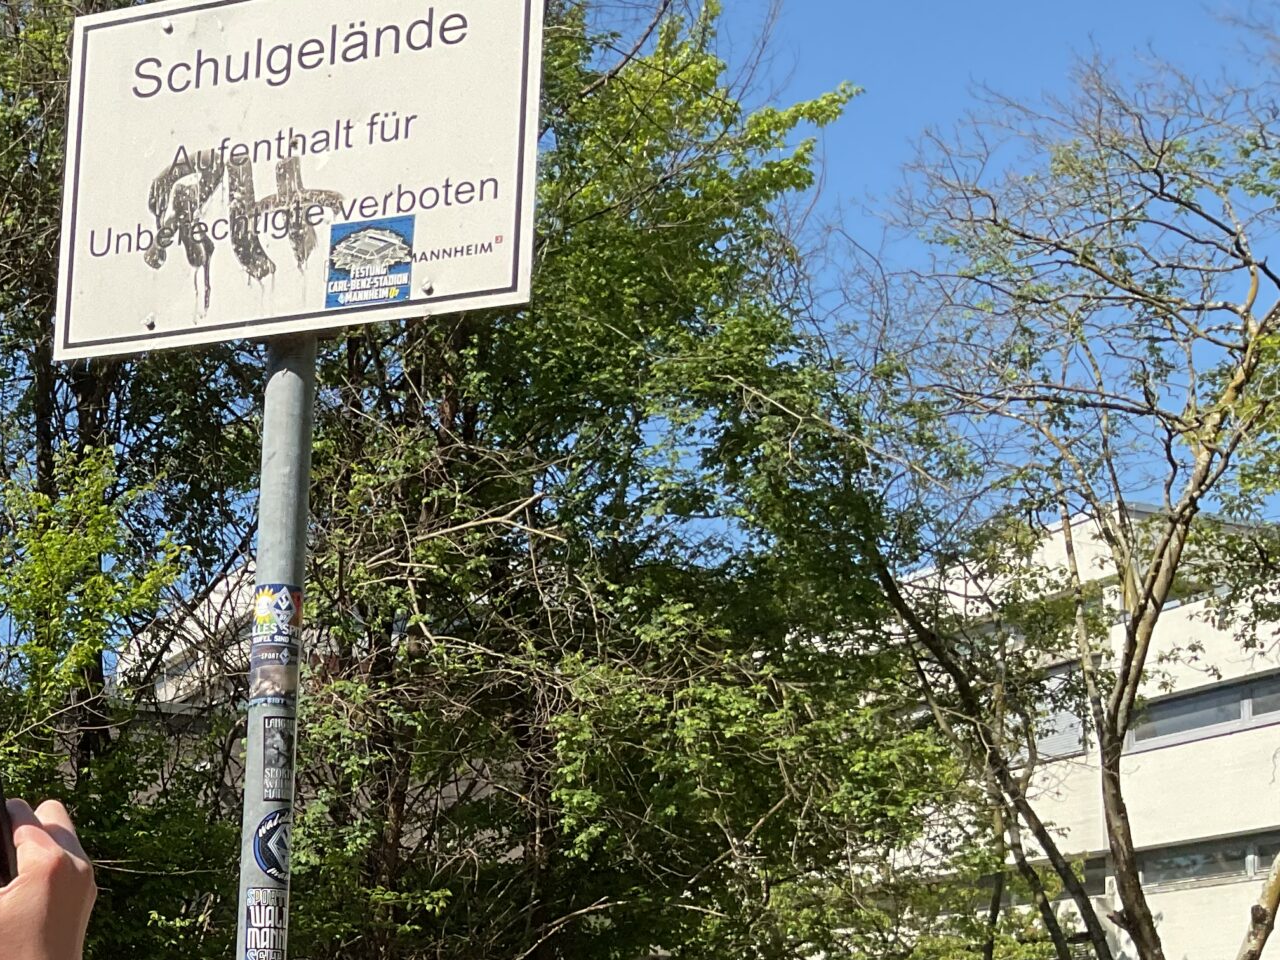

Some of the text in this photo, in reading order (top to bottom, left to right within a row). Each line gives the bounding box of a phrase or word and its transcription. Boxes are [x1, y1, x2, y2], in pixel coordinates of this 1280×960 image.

[132, 7, 468, 98] Schulgelände
[169, 111, 419, 172] Aufenthalt für
[89, 176, 499, 258] Unberechtigte verboten
[328, 272, 409, 293] CARL-BENZ-STADION
[351, 264, 387, 279] FESTUNG
[345, 287, 389, 303] MANNHEIM
